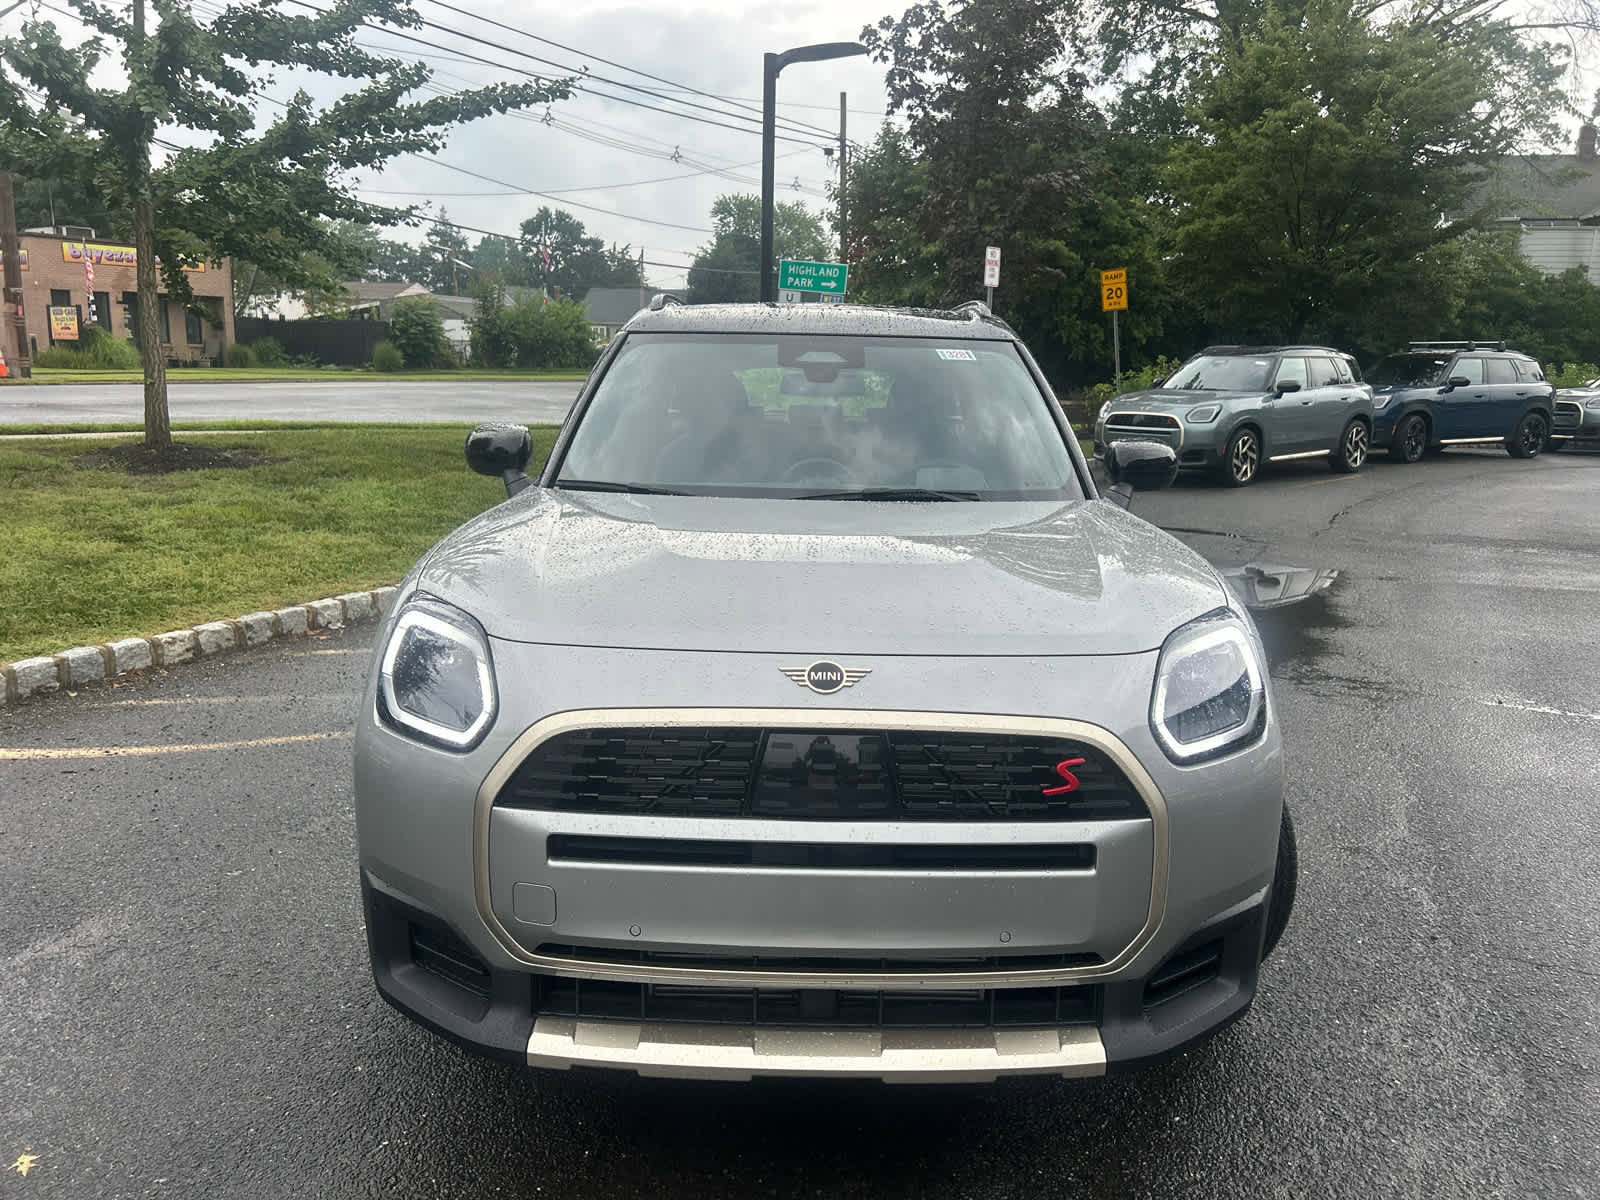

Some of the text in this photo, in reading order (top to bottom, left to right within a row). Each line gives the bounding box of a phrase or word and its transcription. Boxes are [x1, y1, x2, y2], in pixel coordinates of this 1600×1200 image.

[69, 243, 137, 263] buyeza
[788, 264, 839, 278] HIGHLAND
[1104, 272, 1123, 281] RAMP
[787, 277, 813, 287] PARK
[1106, 287, 1123, 300] 20
[810, 671, 840, 681] MINI
[1042, 757, 1086, 796] S
